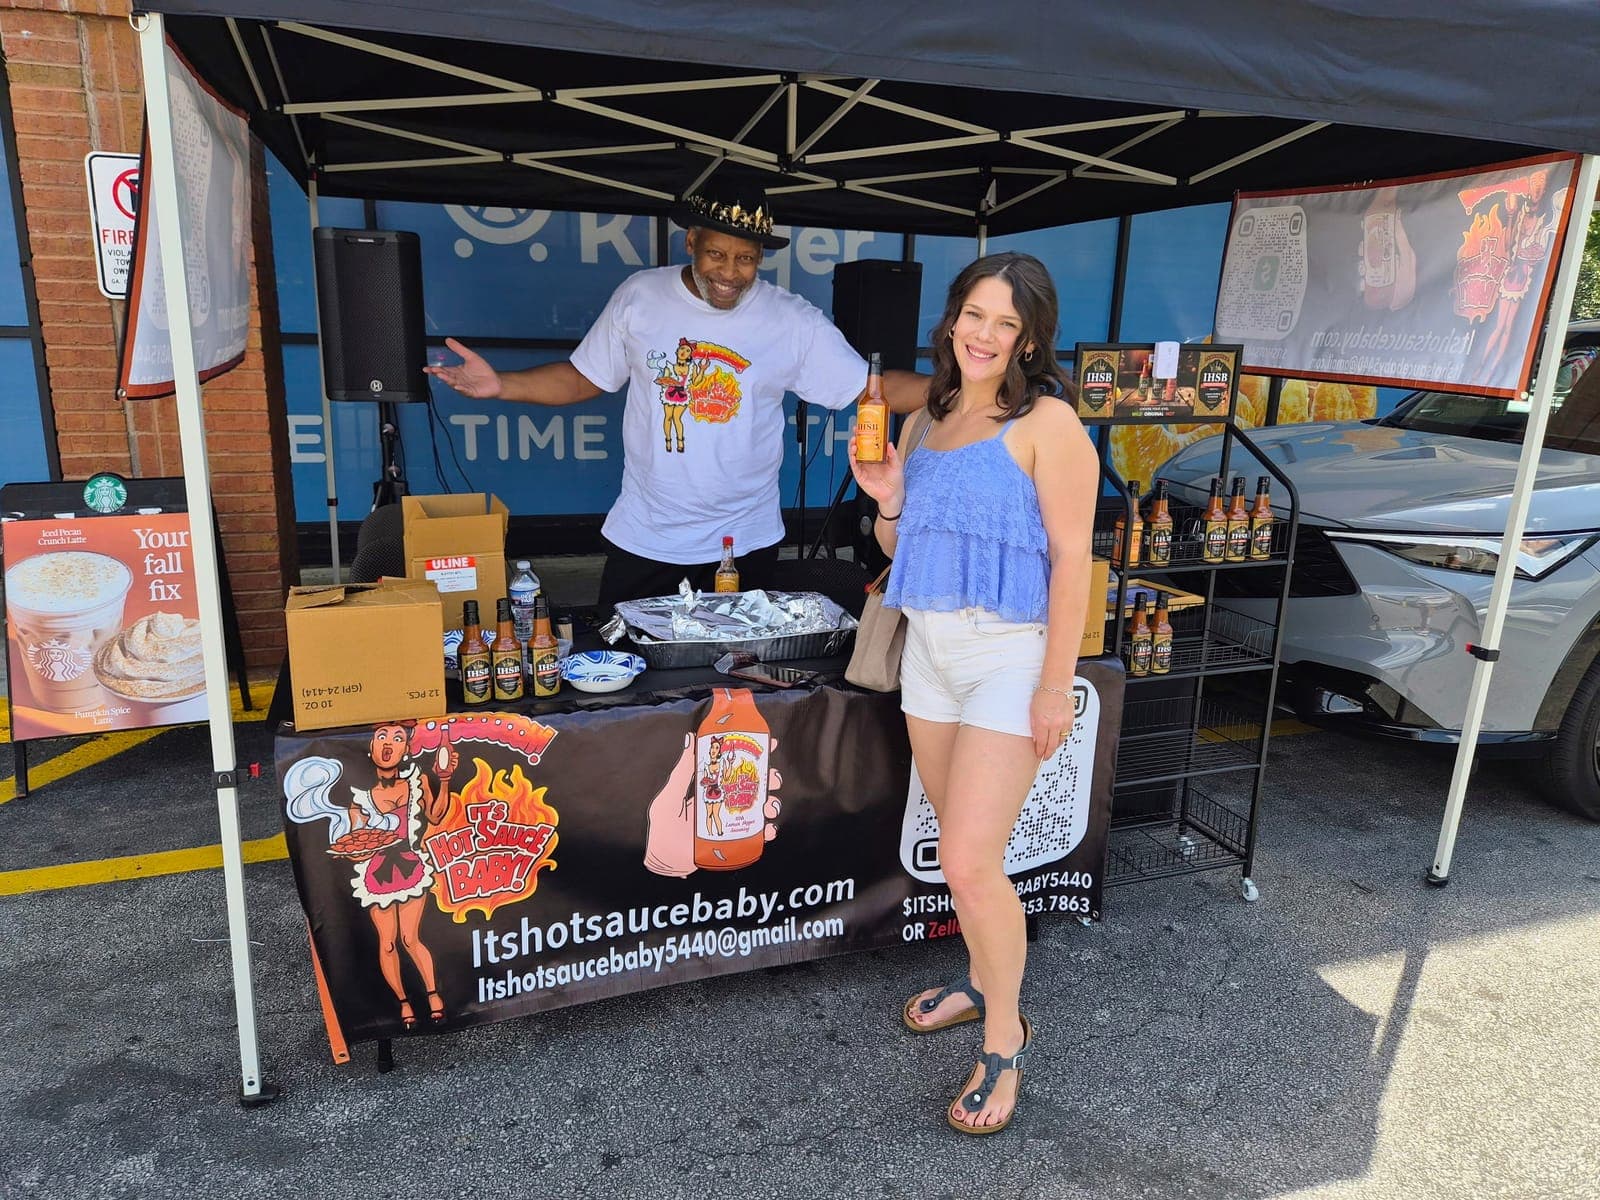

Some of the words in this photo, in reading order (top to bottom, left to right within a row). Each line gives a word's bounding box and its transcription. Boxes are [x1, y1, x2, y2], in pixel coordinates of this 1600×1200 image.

[1087, 372, 1112, 382] IHSB
[1203, 372, 1228, 382] IHSB
[450, 415, 608, 460] TIME
[38, 537, 67, 545] Crunch
[132, 528, 189, 549] Your
[144, 552, 184, 575] fall
[431, 557, 468, 569] ULINE
[149, 579, 182, 602] fix
[496, 665, 520, 675] IHSB
[406, 691, 426, 699] PCS.
[429, 689, 440, 697] 12
[302, 702, 319, 710] OZ.
[321, 700, 333, 709] 10
[469, 801, 506, 821] IT'S
[429, 827, 475, 869] HOT
[476, 819, 552, 854] SAUCE
[448, 853, 533, 900] BABY!
[1013, 871, 1093, 897] BABY5440
[472, 878, 855, 968] Itshotsaucebaby.com
[902, 922, 925, 941] OR
[478, 916, 844, 1003] Itshotsaucebaby5440@gmail.com
